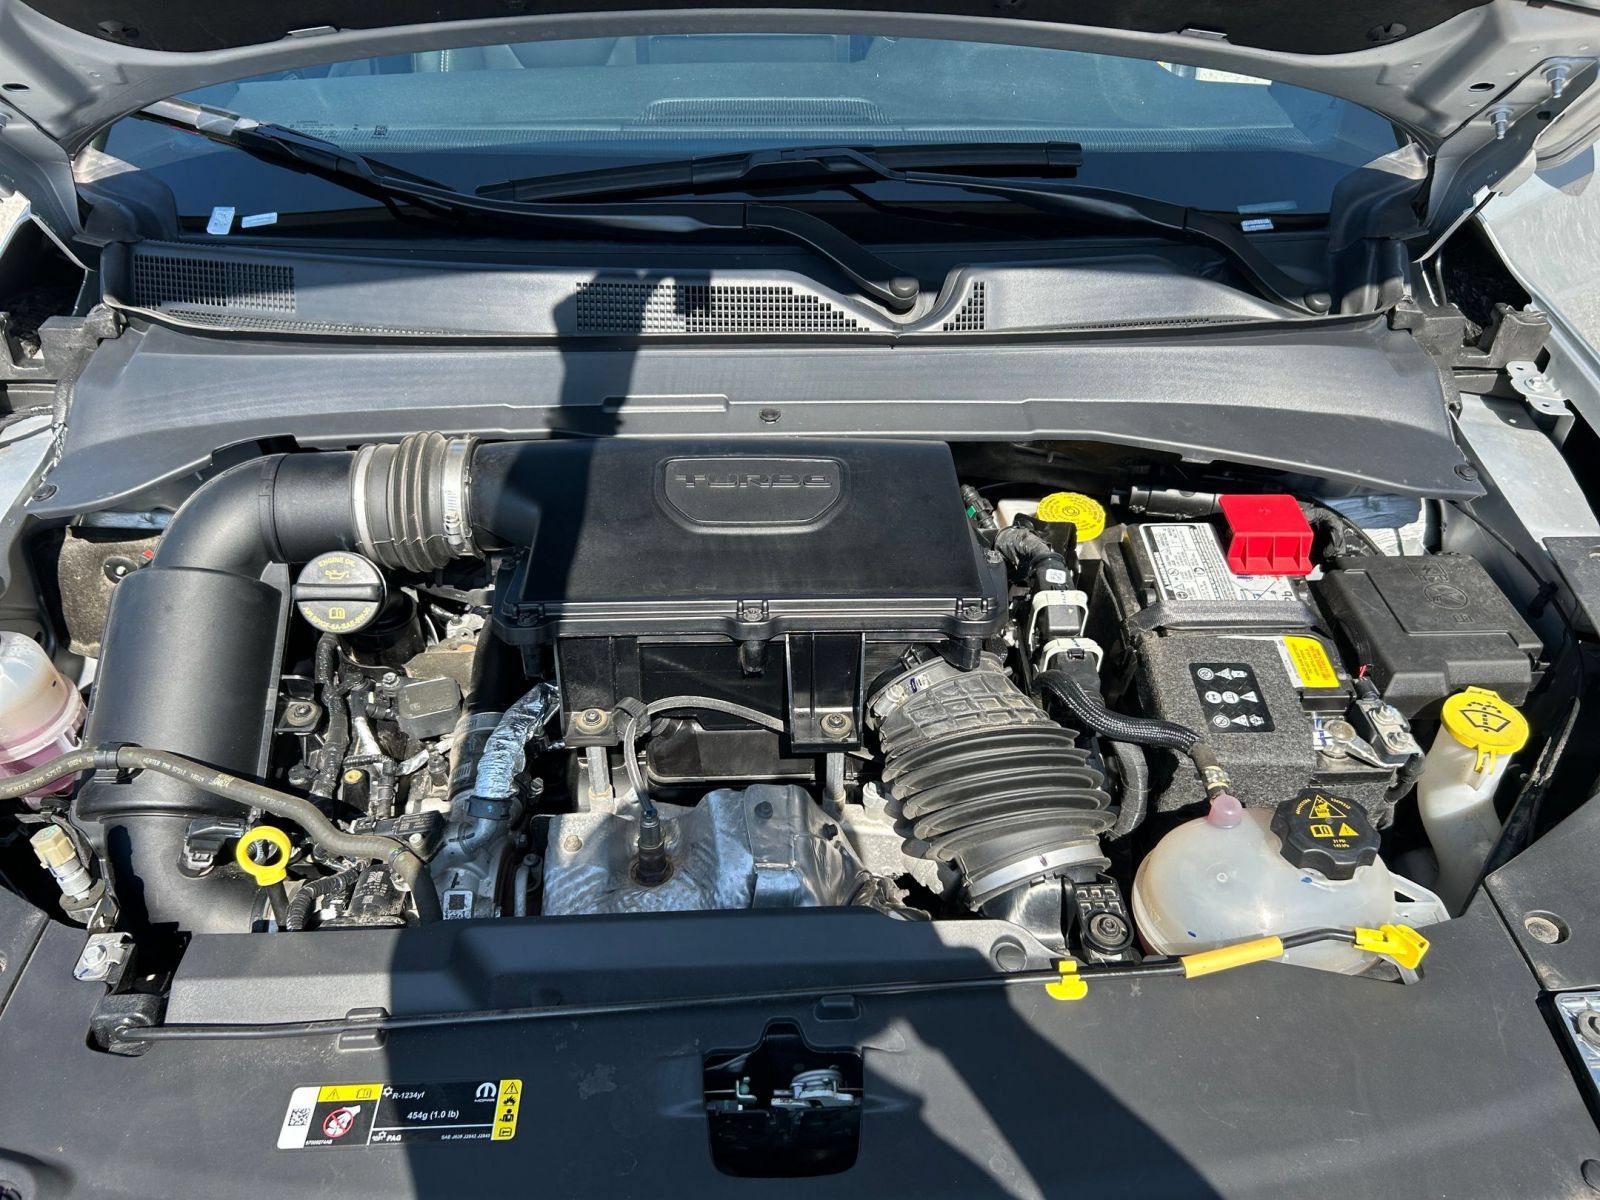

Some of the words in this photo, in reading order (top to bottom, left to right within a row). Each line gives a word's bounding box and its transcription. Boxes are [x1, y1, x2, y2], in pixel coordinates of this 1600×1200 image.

[674, 472, 833, 488] TURBO
[318, 556, 344, 568] ENGINE
[344, 558, 357, 568] OIL
[392, 1091, 426, 1100] R-1234yf
[407, 1111, 428, 1121] 454g
[429, 1110, 446, 1120] (1.0
[447, 1109, 460, 1119] lb)
